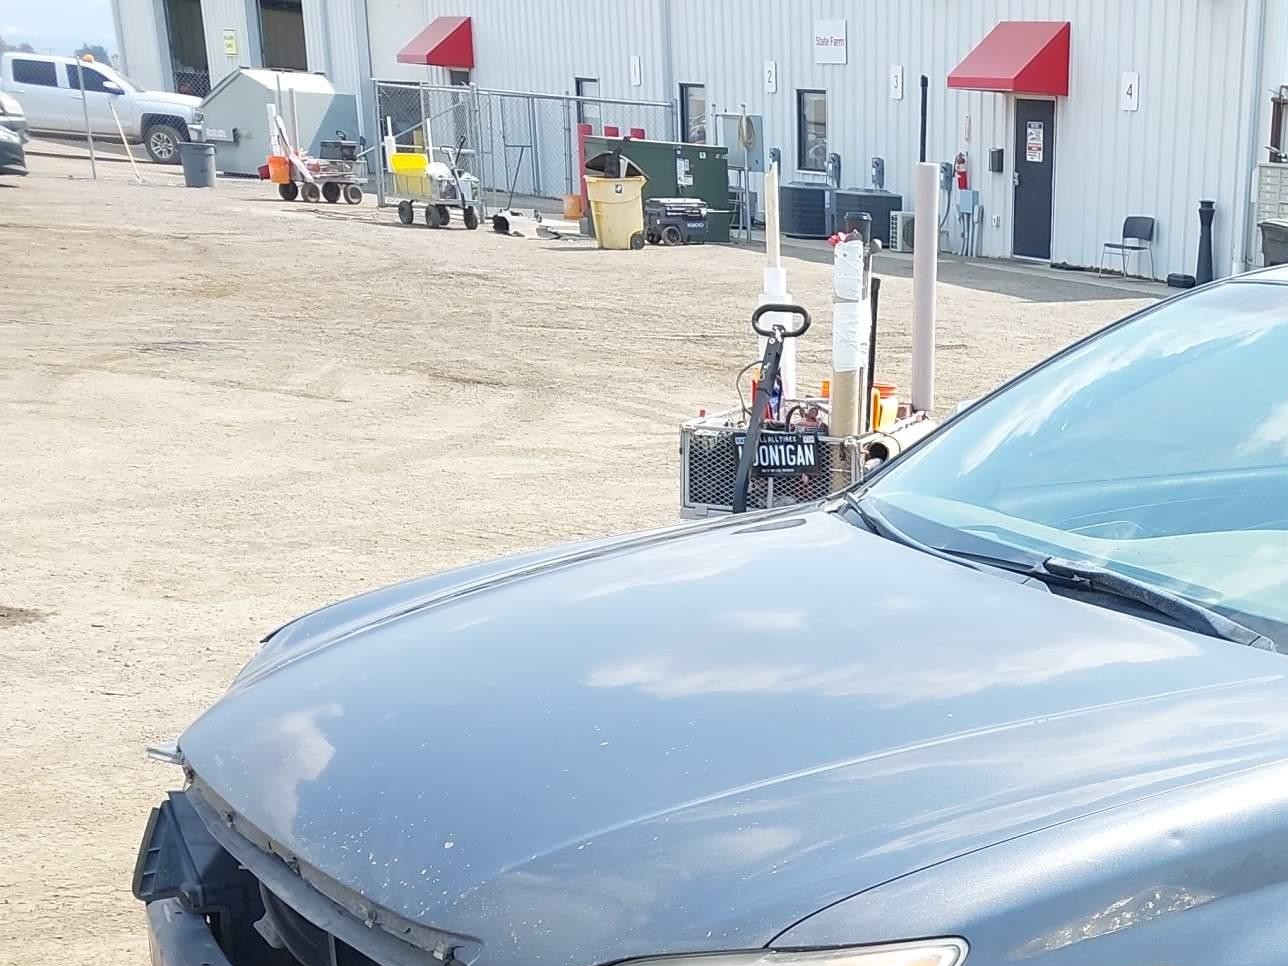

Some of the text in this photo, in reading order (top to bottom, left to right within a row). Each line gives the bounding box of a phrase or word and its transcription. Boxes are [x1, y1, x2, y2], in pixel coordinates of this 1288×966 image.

[815, 36, 845, 47] State Farm
[767, 70, 773, 83] 2
[893, 74, 899, 89] 3
[1126, 83, 1133, 100] 4
